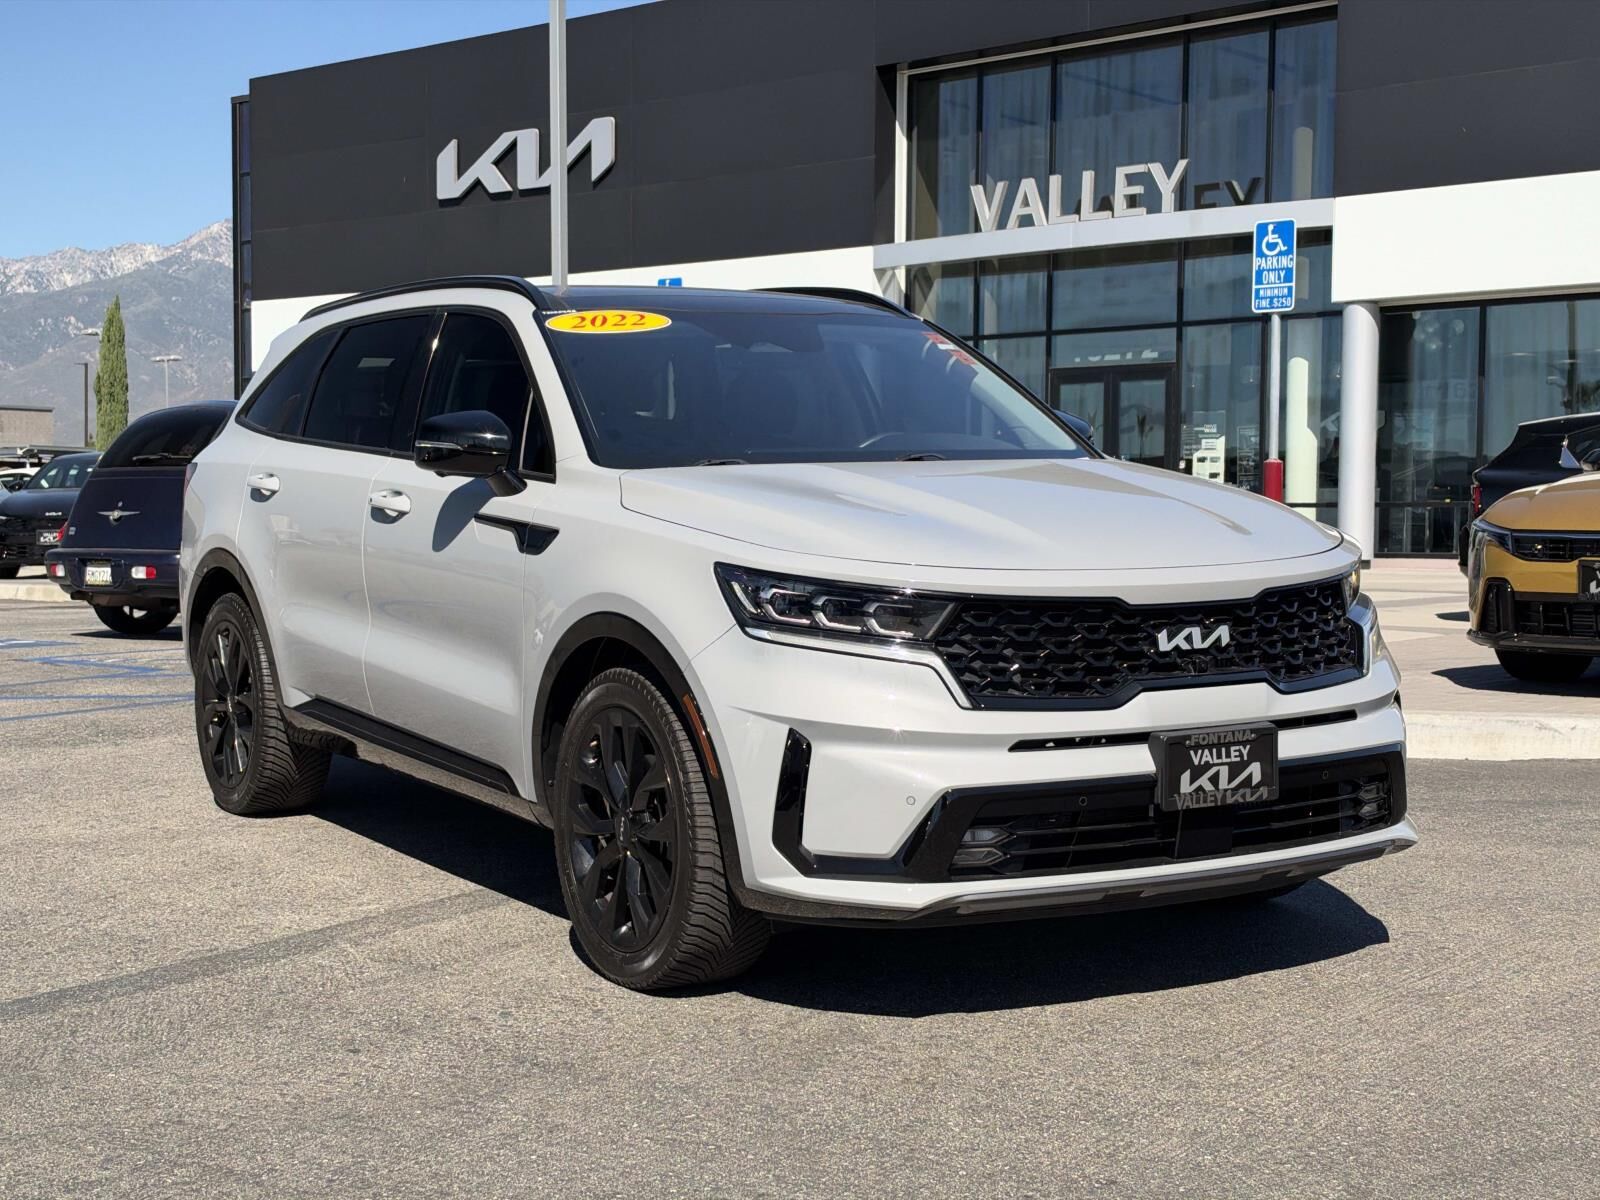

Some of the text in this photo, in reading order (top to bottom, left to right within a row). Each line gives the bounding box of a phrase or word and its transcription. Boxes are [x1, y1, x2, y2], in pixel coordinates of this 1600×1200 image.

[436, 116, 616, 201] KIA
[970, 158, 1190, 232] VALLEY
[1255, 254, 1294, 271] PARKING
[1262, 270, 1286, 285] ONLY
[1259, 287, 1288, 298] MINIMUM
[1255, 297, 1292, 309] FINE $250
[570, 313, 646, 329] 2022
[1157, 625, 1230, 652] KIA
[1190, 729, 1252, 746] FONTANA
[1189, 744, 1251, 766] VALLEY
[1180, 761, 1262, 794] KIA
[1174, 785, 1268, 811] VALLEY KIA
